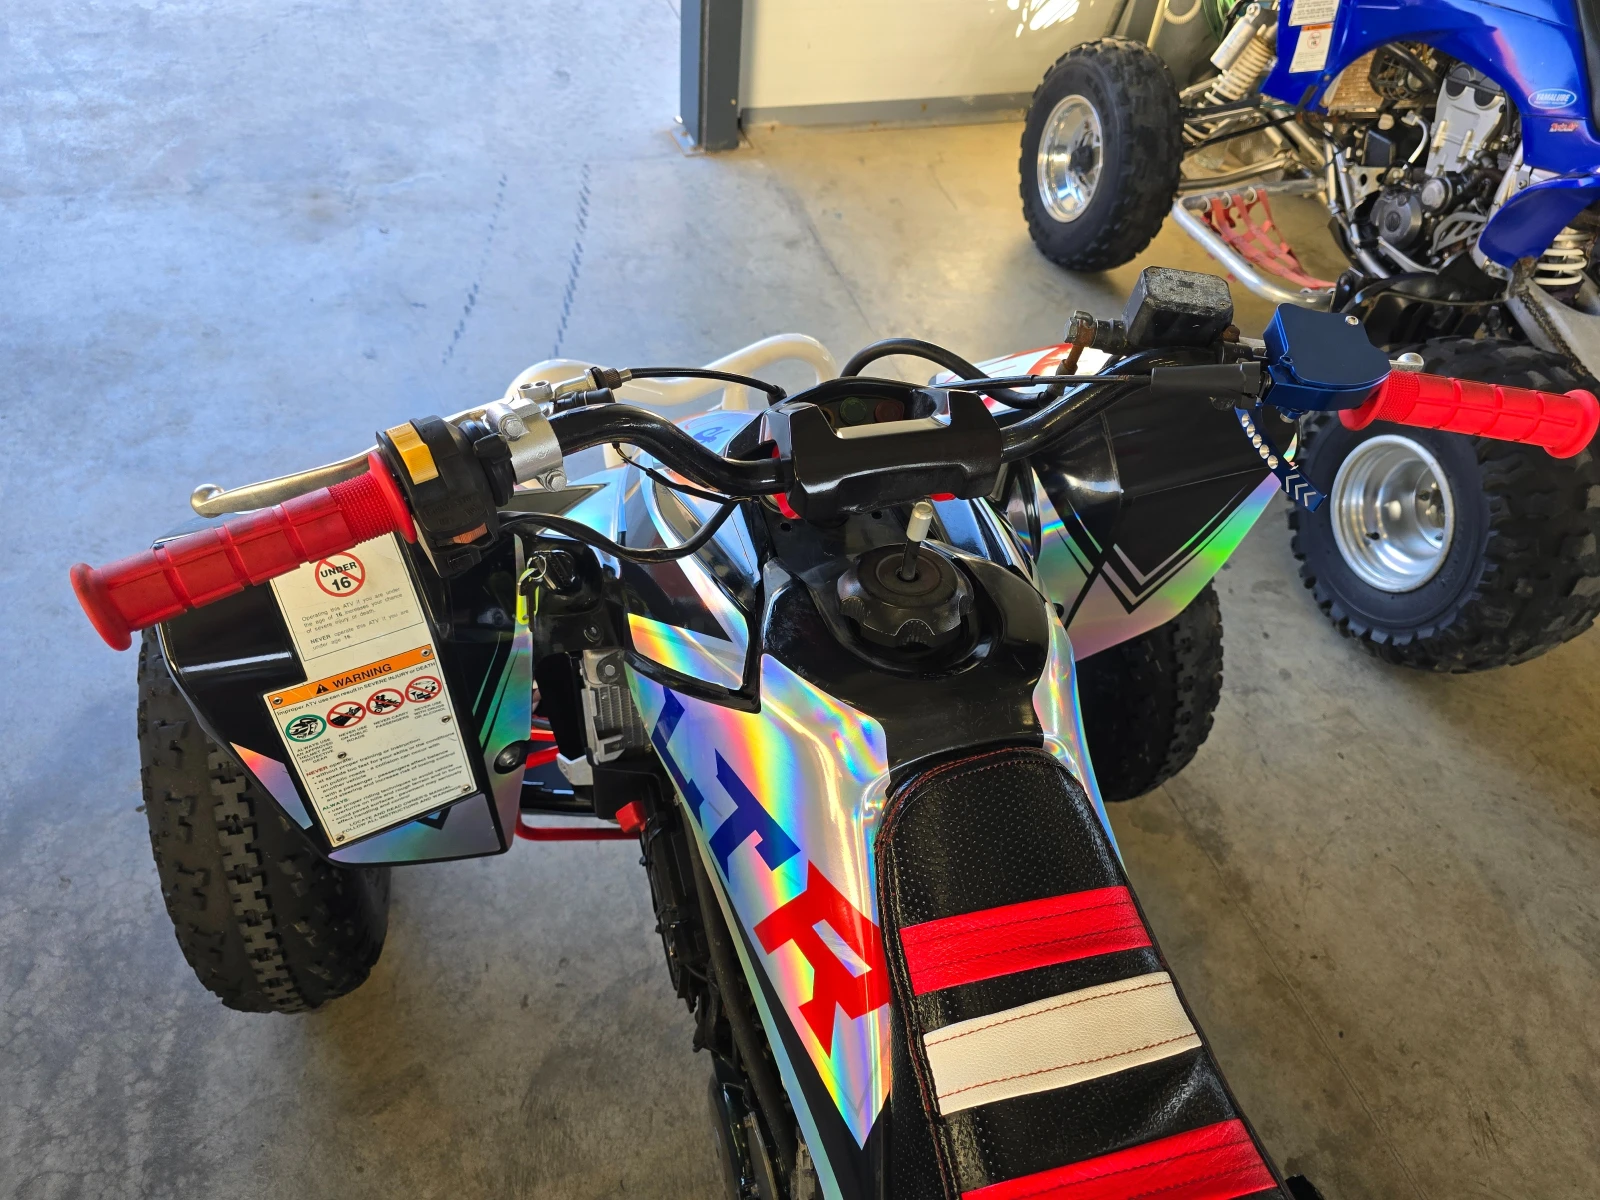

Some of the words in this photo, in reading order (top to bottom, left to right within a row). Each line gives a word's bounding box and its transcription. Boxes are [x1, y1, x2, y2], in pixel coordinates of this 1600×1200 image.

[1536, 93, 1571, 102] YAMALUBE
[320, 561, 357, 577] UNDER
[332, 575, 351, 591] 16
[345, 604, 369, 614] increases
[385, 594, 402, 602] chance
[302, 611, 328, 621] Operating
[315, 623, 332, 631] severe
[310, 635, 331, 644] NEVER
[334, 628, 354, 636] operate
[332, 664, 392, 688] WARNING
[277, 706, 303, 715] Improper
[341, 688, 357, 696] result
[364, 678, 387, 688] SEVERE
[388, 671, 408, 680] INJURY
[416, 661, 436, 671] DEATH
